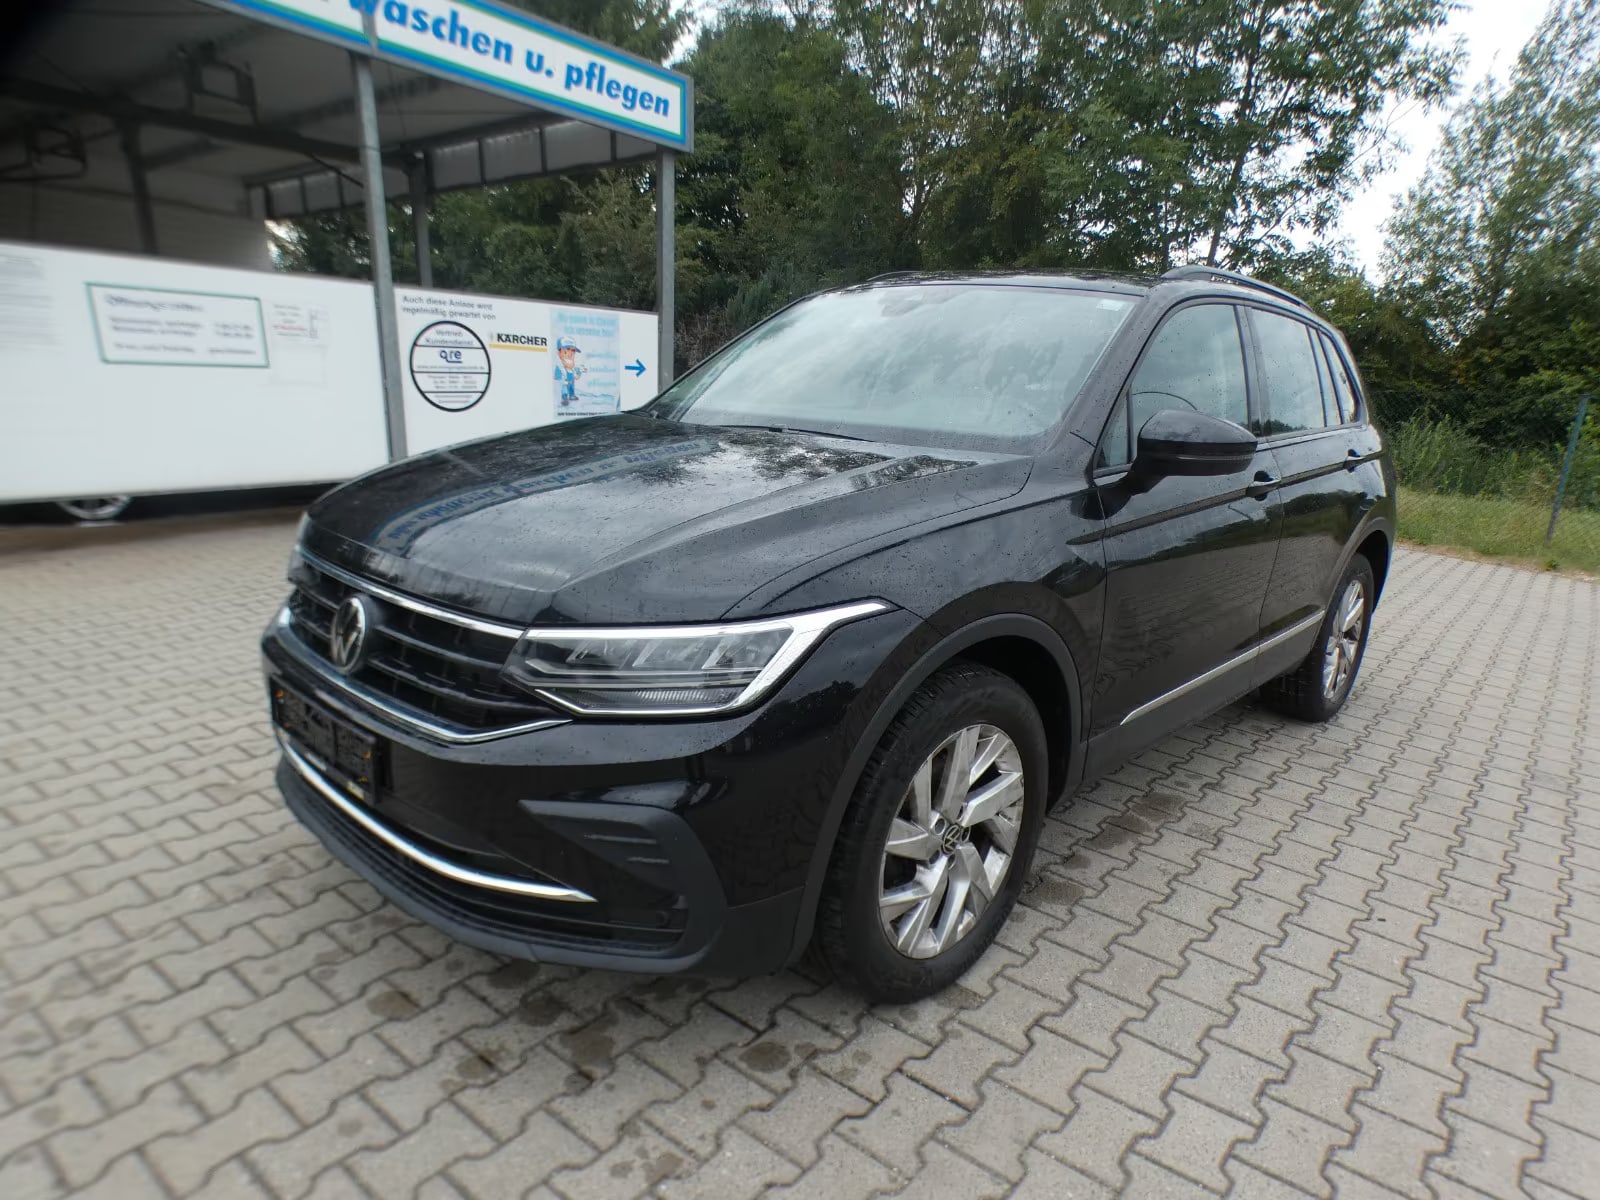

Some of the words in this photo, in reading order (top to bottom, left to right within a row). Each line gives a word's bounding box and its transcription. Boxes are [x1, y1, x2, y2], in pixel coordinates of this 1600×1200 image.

[525, 49, 554, 77] u.
[565, 61, 670, 116] pflegen
[497, 332, 547, 346] KÄRCHER
